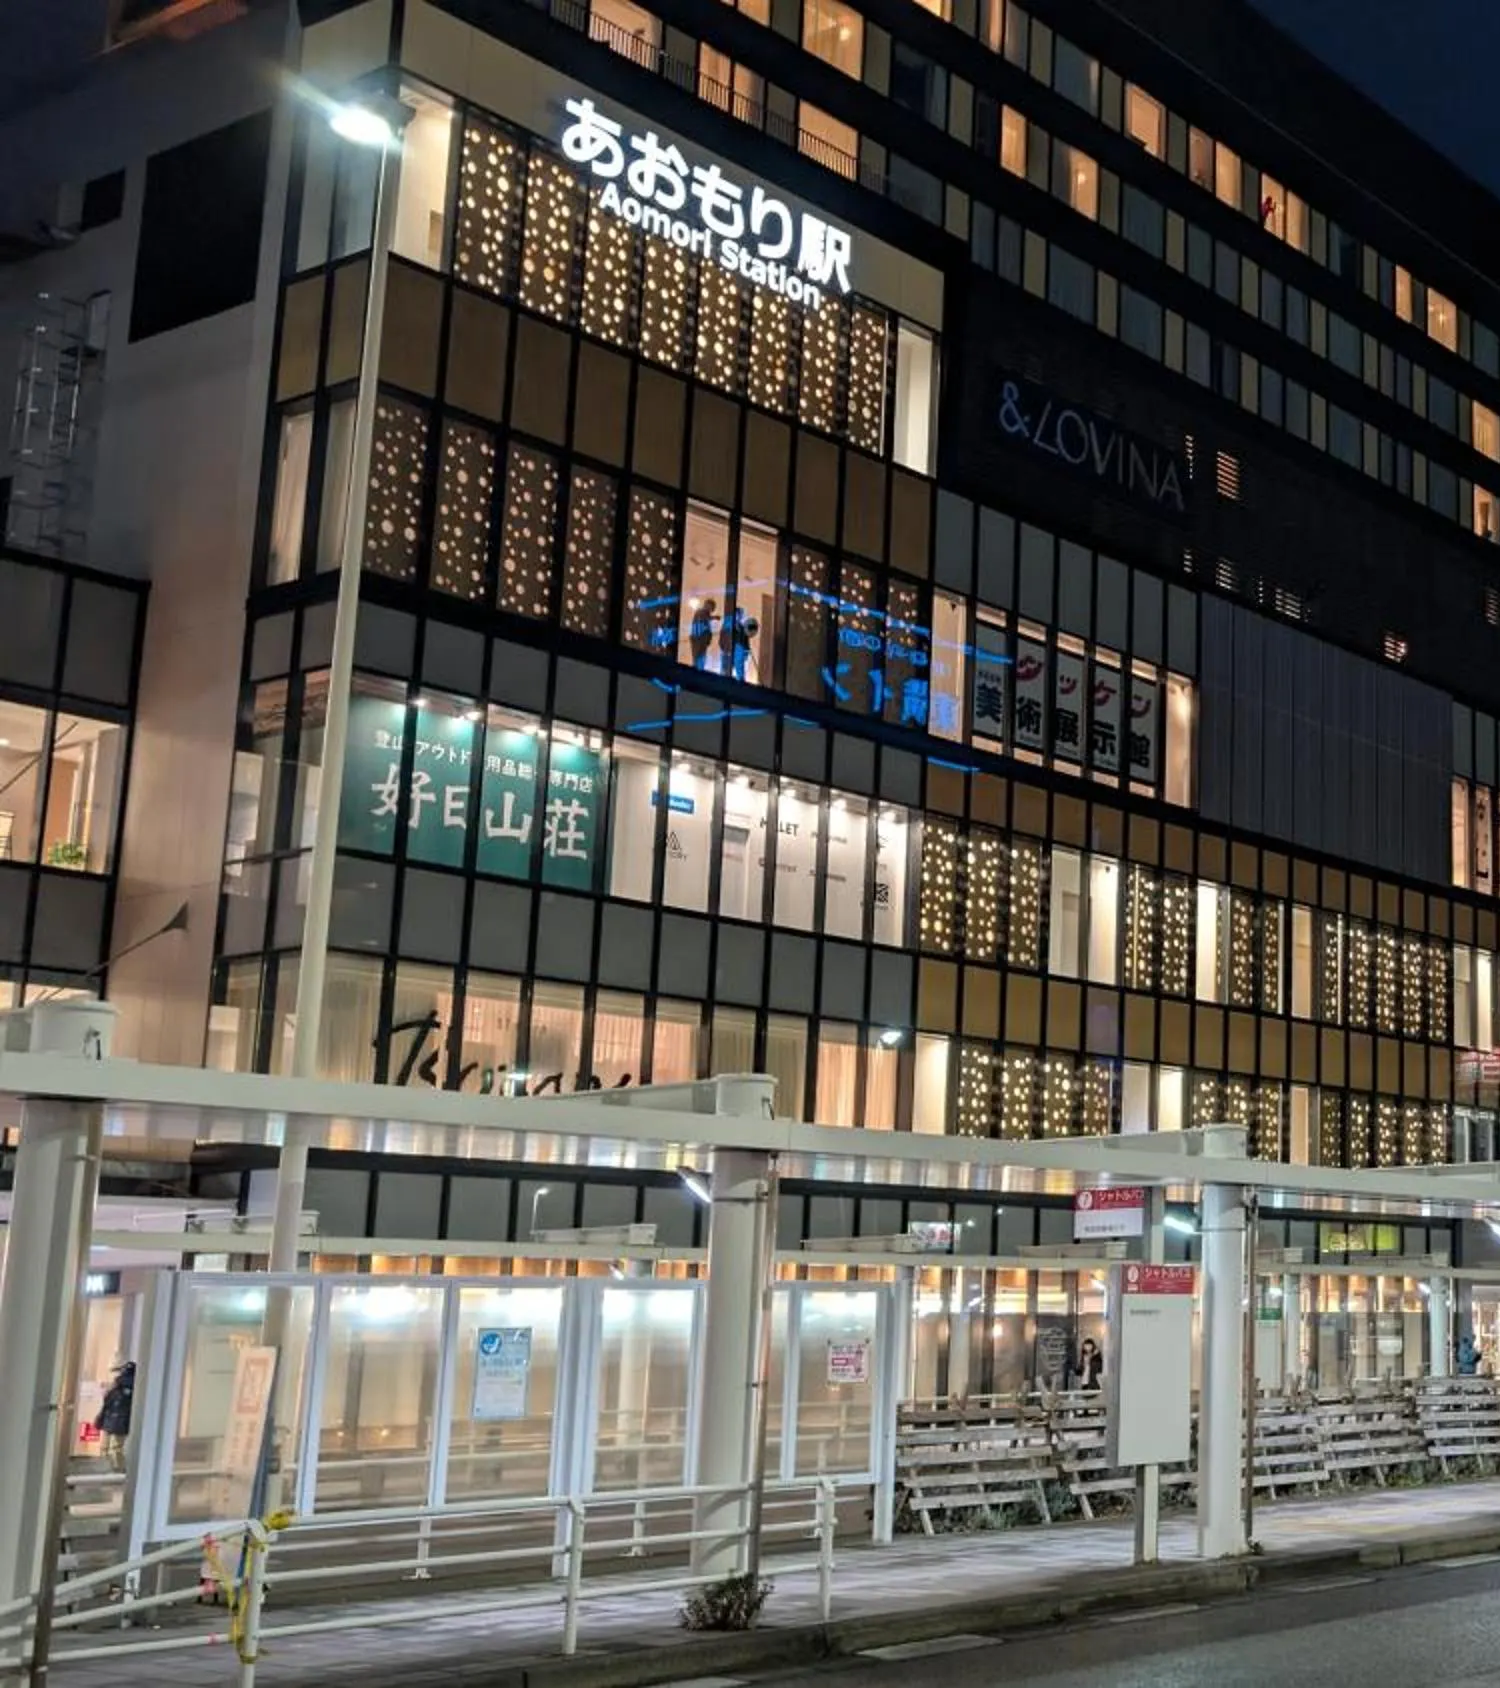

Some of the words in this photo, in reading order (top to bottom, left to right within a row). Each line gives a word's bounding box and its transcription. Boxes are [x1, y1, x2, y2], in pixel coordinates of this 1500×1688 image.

[561, 97, 853, 294] あおもり駅
[599, 184, 712, 258] Aomori
[719, 239, 822, 310] Station
